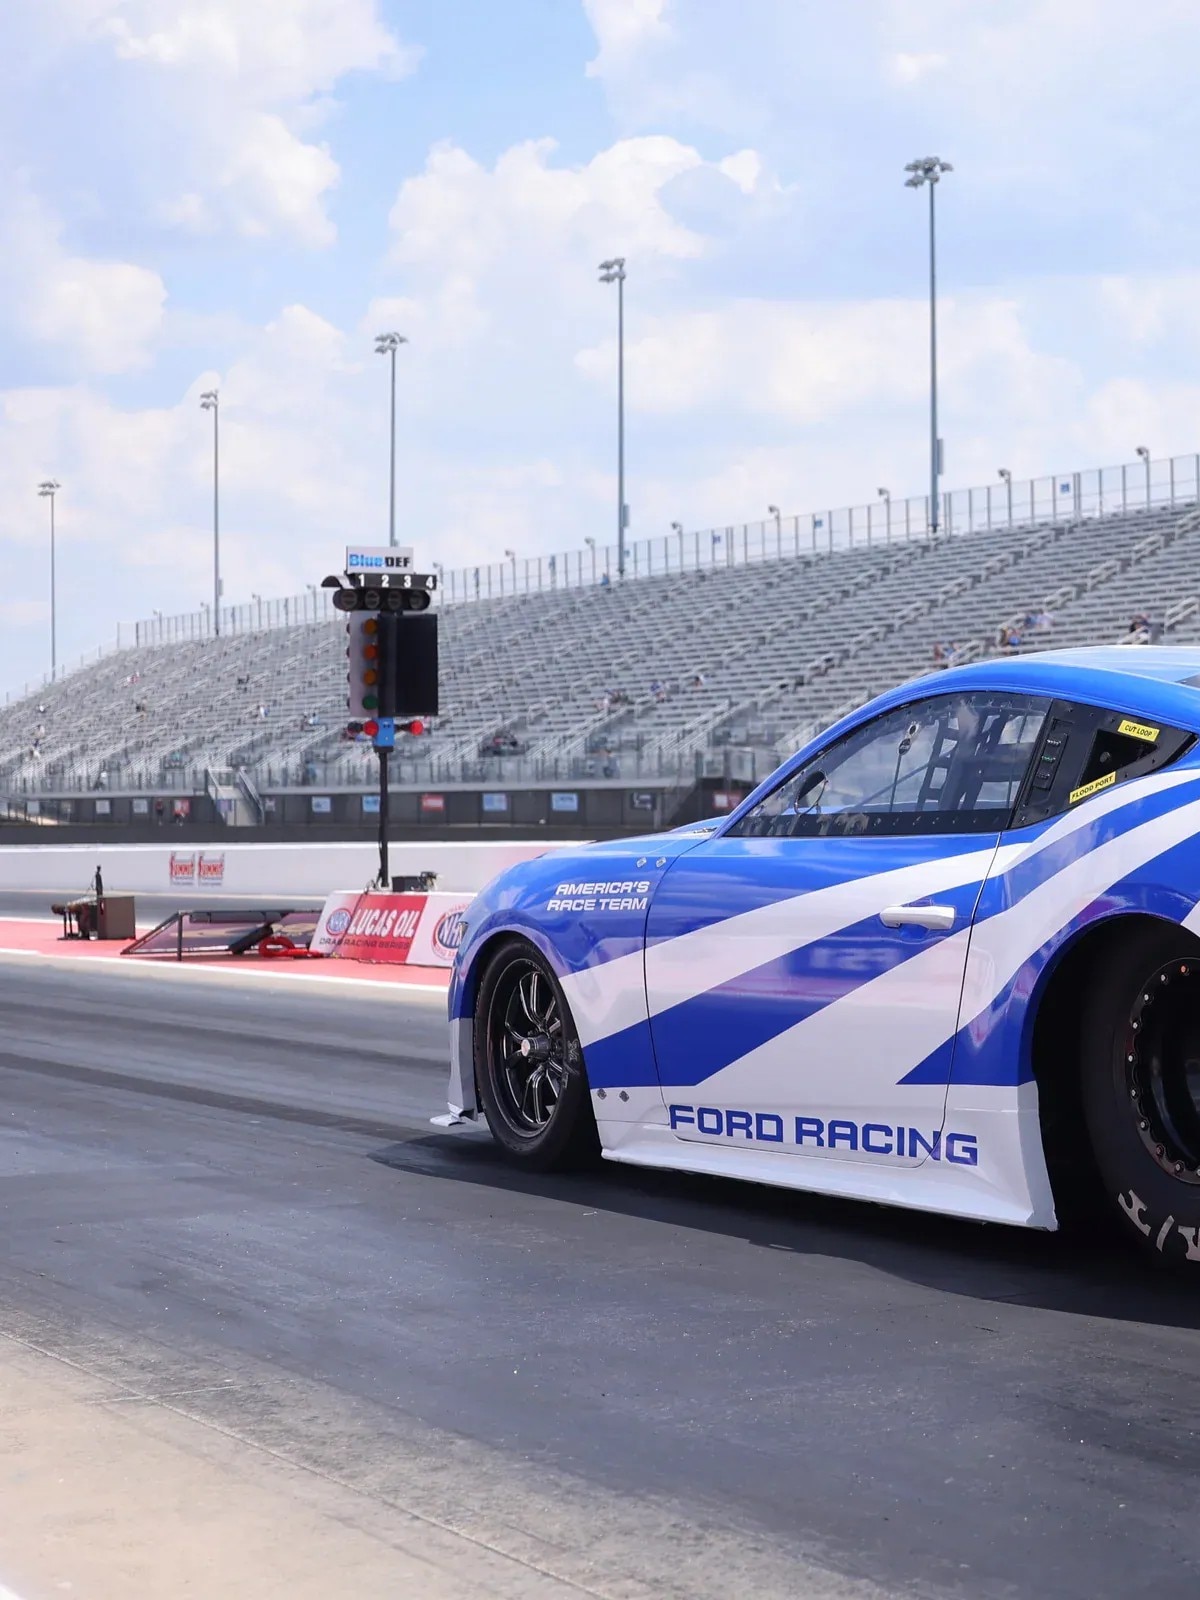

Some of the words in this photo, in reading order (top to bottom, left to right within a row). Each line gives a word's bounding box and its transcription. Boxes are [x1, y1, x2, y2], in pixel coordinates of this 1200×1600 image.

[358, 573, 366, 588] 1
[381, 574, 390, 589] 2
[403, 575, 412, 589] 3
[425, 576, 434, 590] 4
[1124, 724, 1138, 734] CUT
[1137, 728, 1153, 738] LOOP
[1071, 784, 1095, 800] FLOOD
[1095, 775, 1114, 790] PORT
[555, 881, 651, 896] AMERICA'S
[546, 898, 597, 912] RACE
[599, 897, 648, 911] TEAM
[347, 908, 397, 938] LUCAS
[392, 909, 421, 938] OIL
[668, 1104, 784, 1143] FORD
[794, 1116, 979, 1167] RACING
